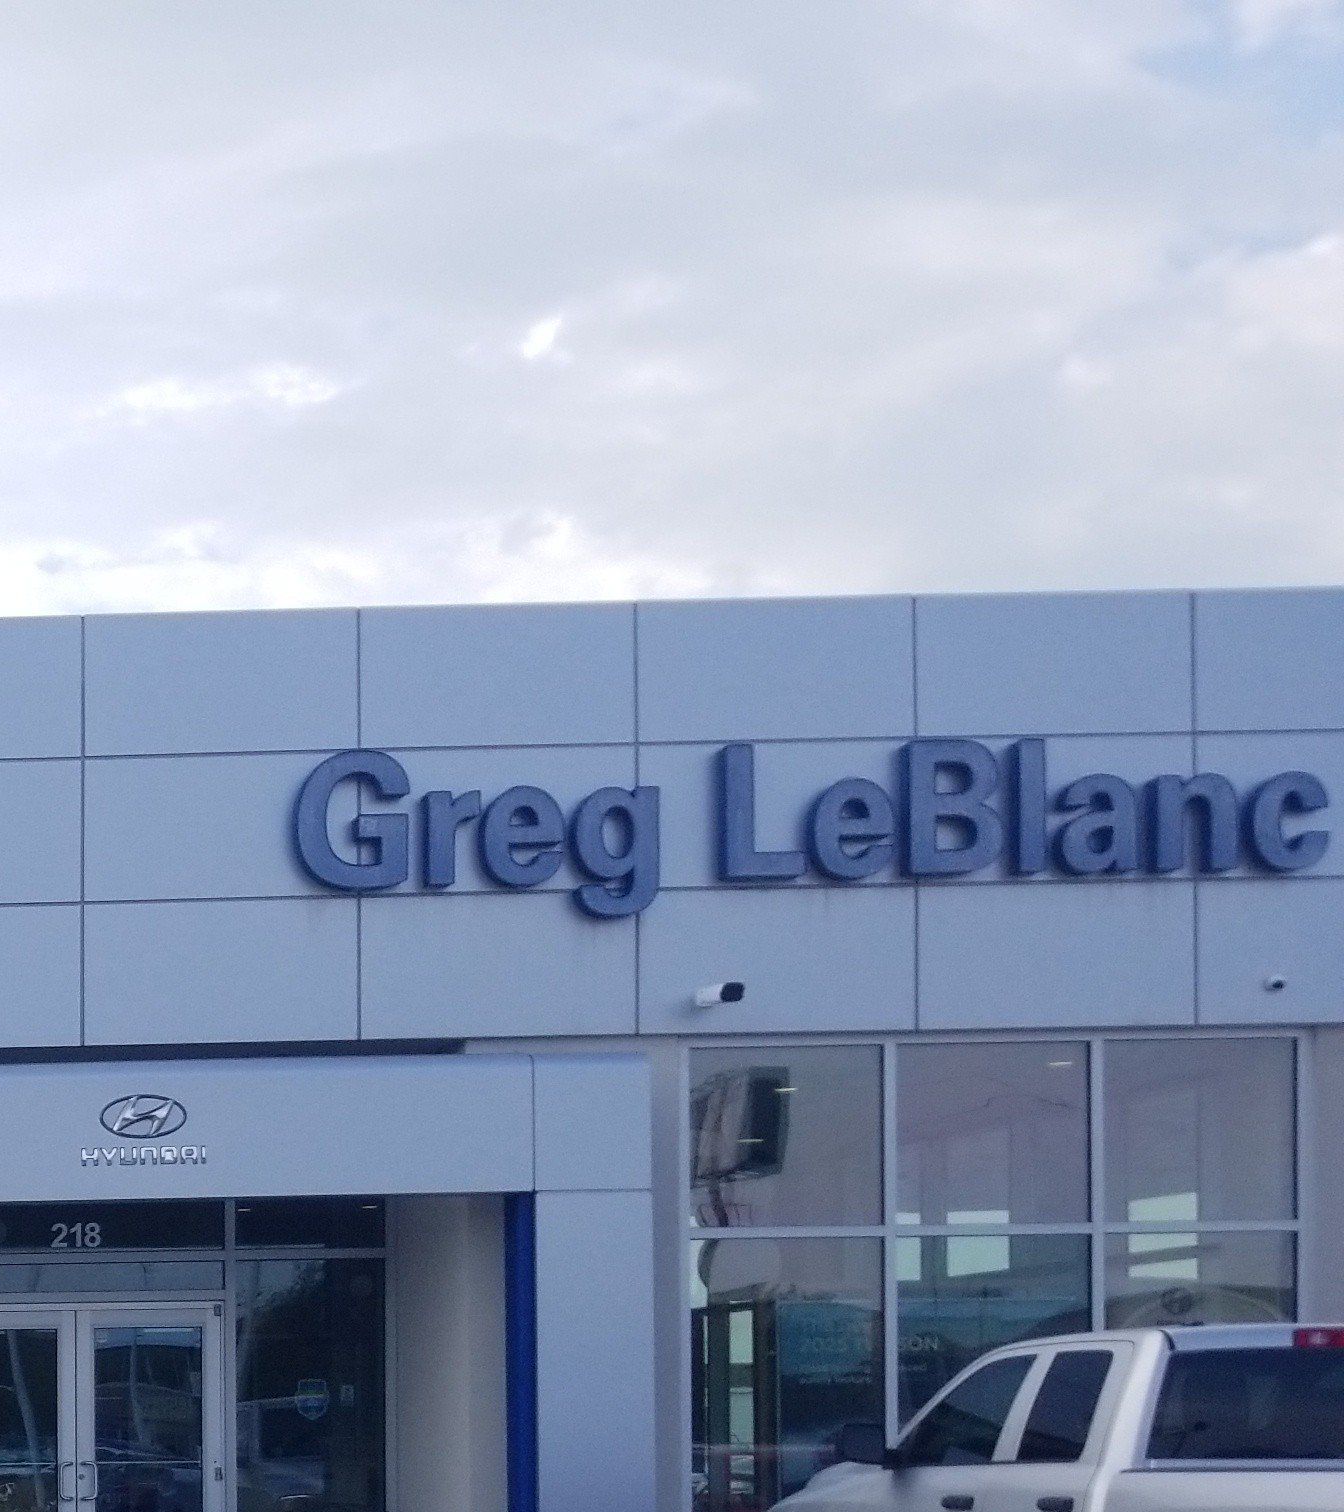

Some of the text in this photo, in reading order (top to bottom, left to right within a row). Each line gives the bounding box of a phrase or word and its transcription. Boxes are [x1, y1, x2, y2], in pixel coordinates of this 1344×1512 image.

[293, 737, 1330, 919] Greg LeBlanc
[80, 1145, 207, 1167] HYUNDAI
[50, 1222, 102, 1248] 218
